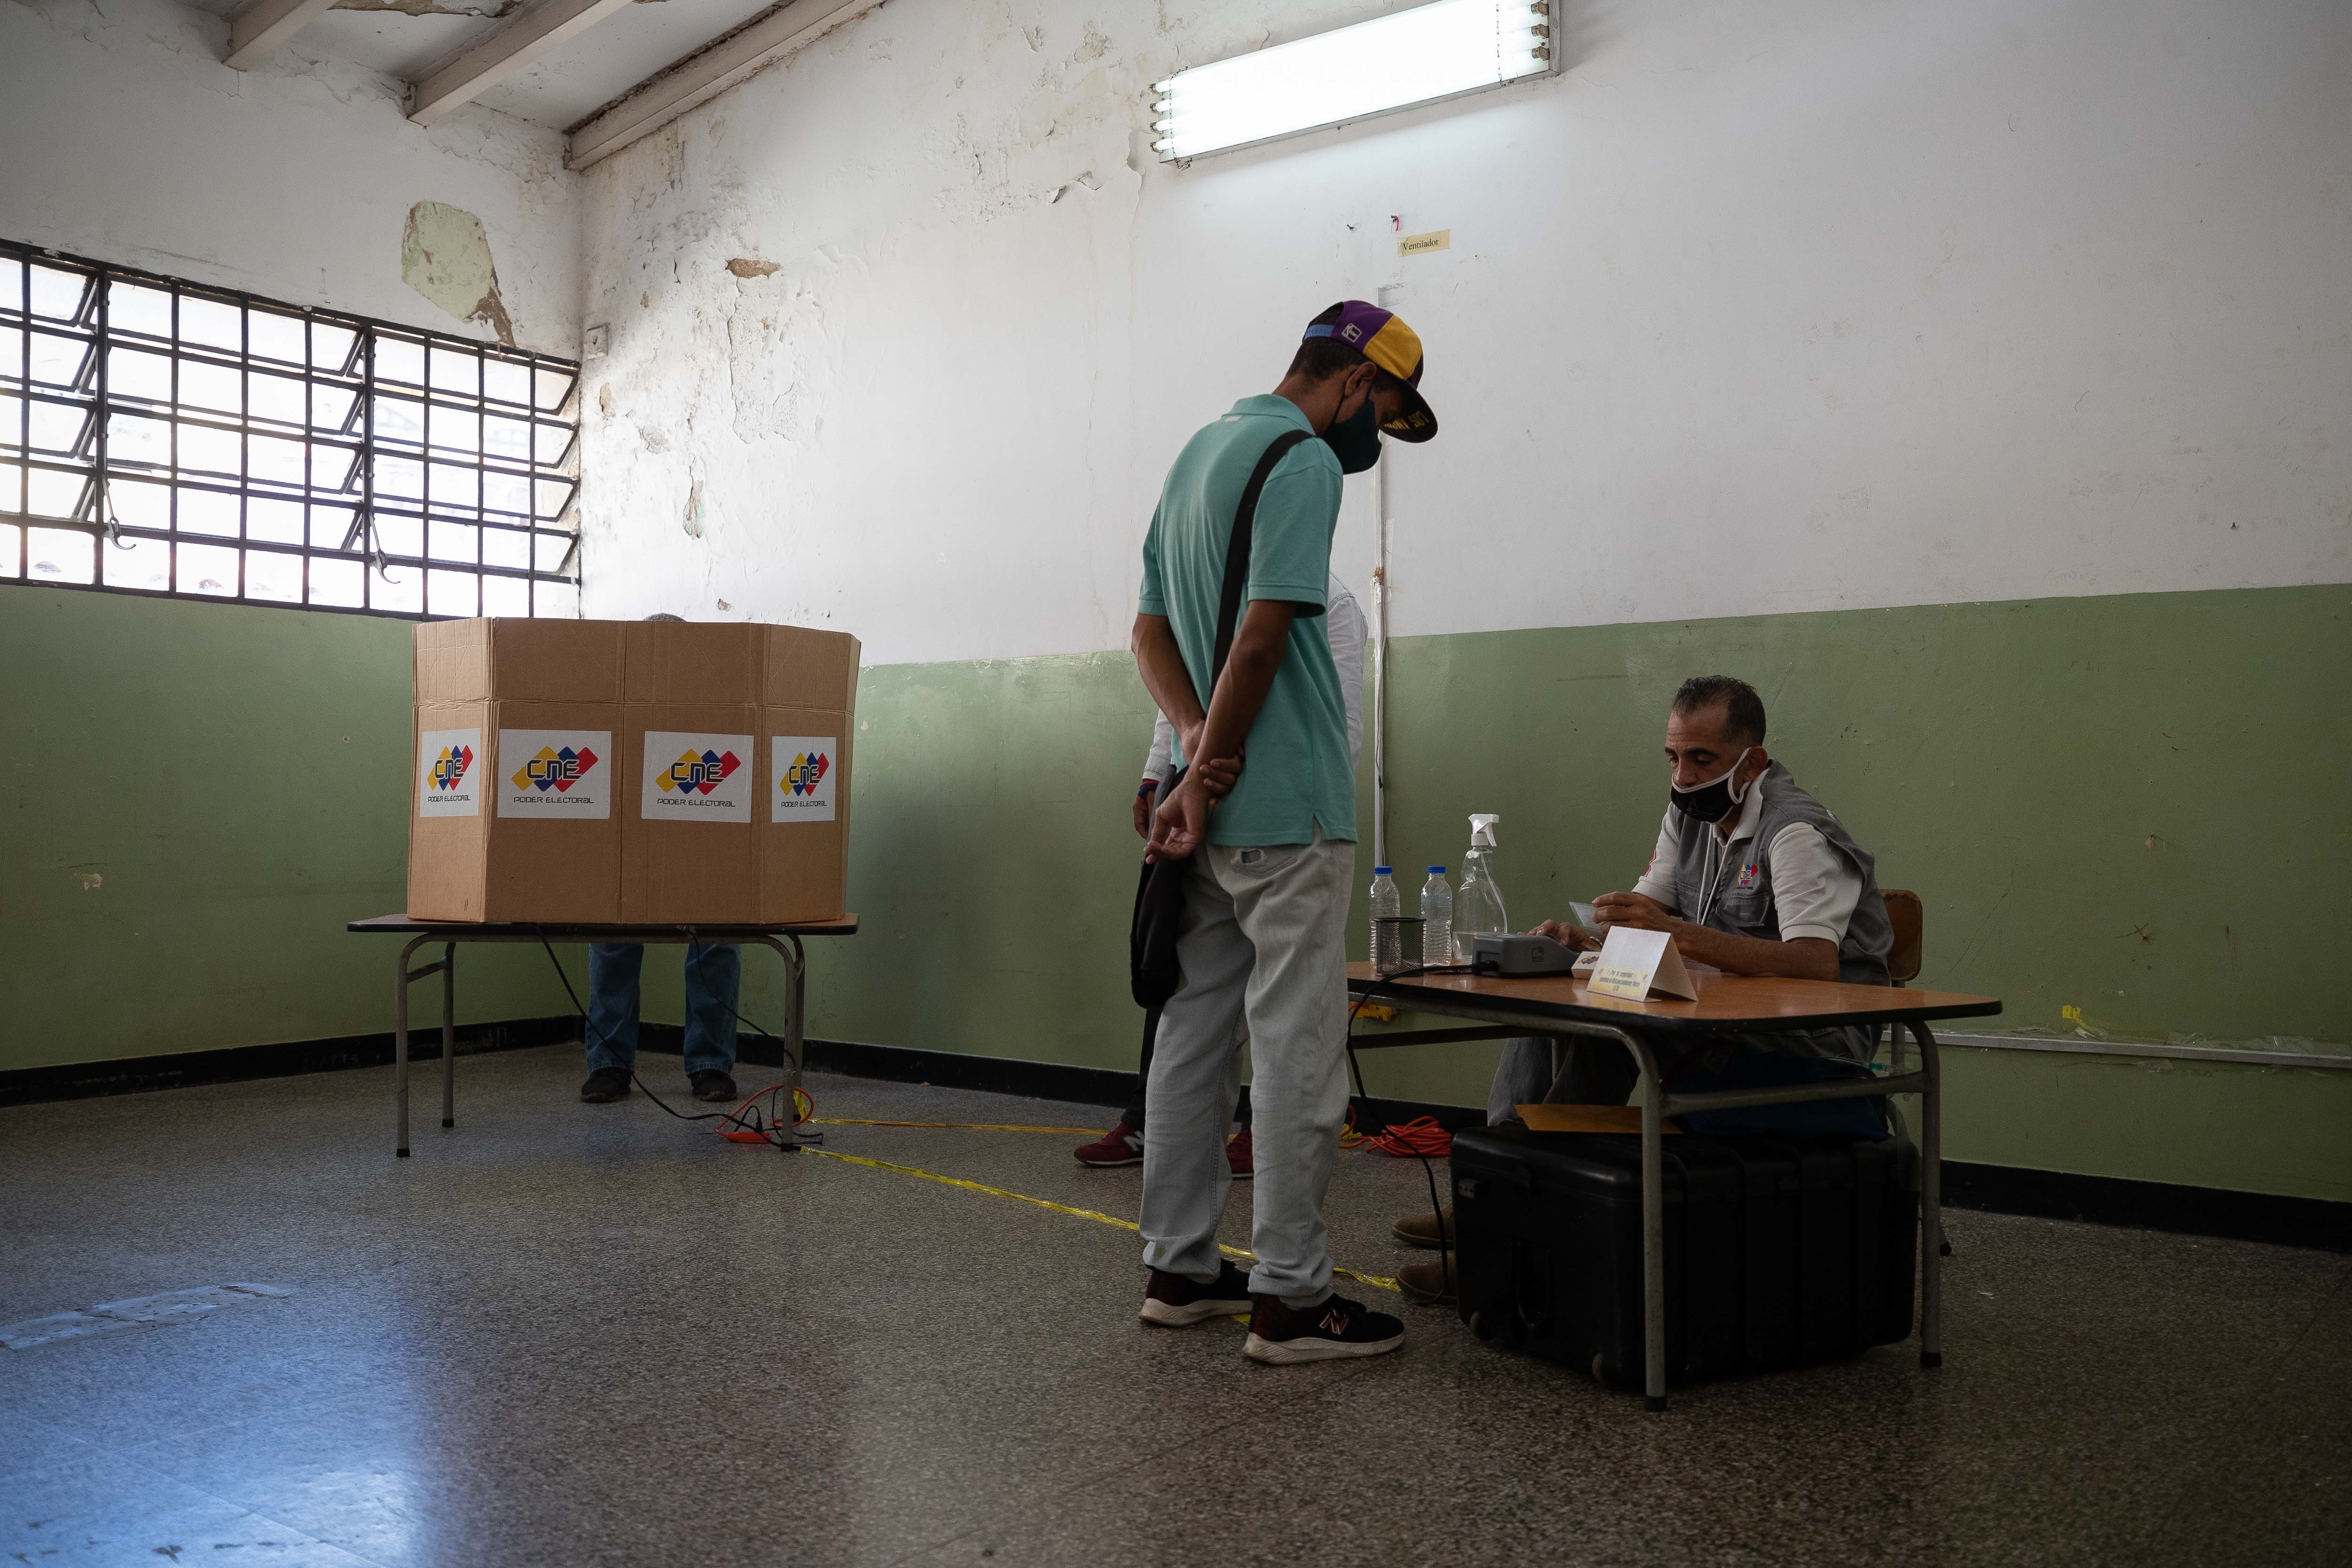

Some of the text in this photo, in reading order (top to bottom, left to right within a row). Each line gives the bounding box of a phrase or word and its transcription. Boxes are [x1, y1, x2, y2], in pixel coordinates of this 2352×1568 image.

[1403, 239, 1439, 250] Ventilador
[435, 758, 464, 779] CNE
[526, 759, 583, 780] CNE
[670, 762, 725, 783] CNE
[788, 764, 821, 785] CNE
